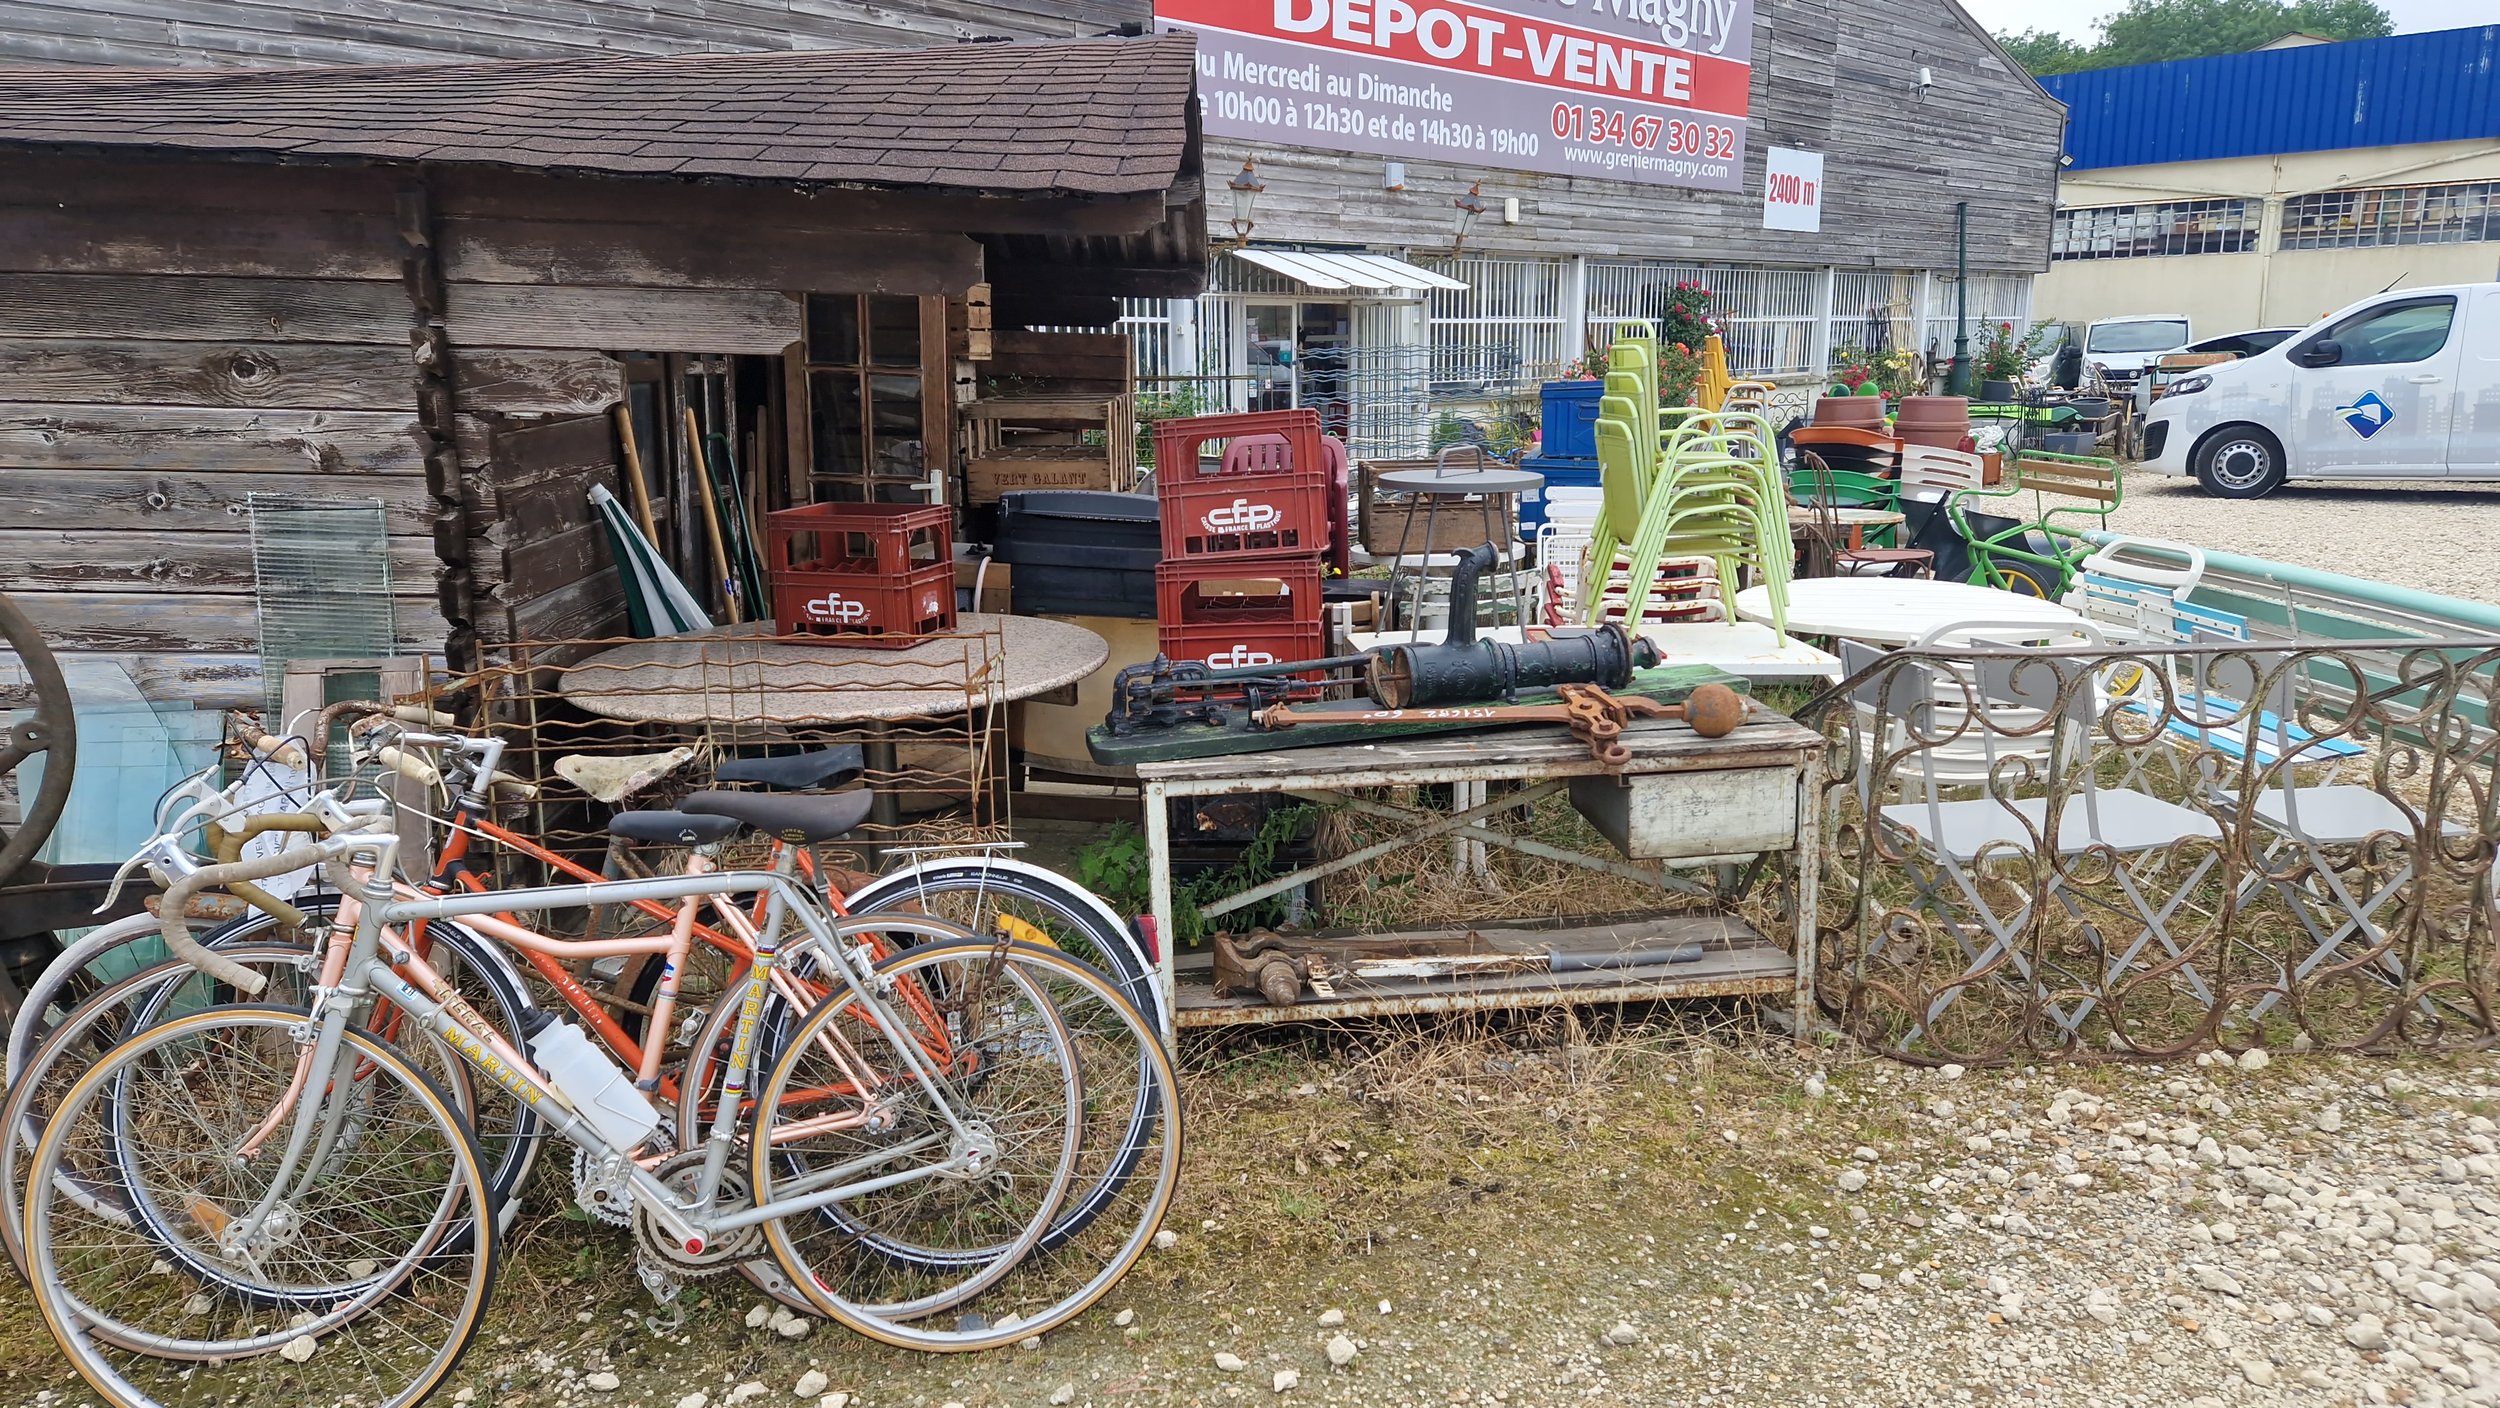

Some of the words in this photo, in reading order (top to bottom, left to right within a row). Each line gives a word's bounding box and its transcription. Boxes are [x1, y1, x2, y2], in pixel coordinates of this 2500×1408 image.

[1593, 0, 1737, 54] agny
[1223, 50, 1320, 93] Mercredi
[1326, 74, 1351, 98] au
[1358, 73, 1453, 112] Dimanche
[1214, 90, 1281, 125] 10h00
[1285, 98, 1298, 127] à
[1303, 102, 1364, 136] 12h30
[1368, 114, 1388, 139] et
[1391, 113, 1416, 142] de
[1420, 118, 1472, 150] 14h30
[1475, 125, 1486, 151] à
[1490, 129, 1539, 157] 19h00
[1551, 101, 1584, 142] 01
[1588, 107, 1626, 147] 34
[1630, 114, 1664, 151] 67
[1667, 119, 1701, 155] 30
[1704, 125, 1736, 161] 32
[1564, 147, 1728, 180] www.greniermagny.com
[1768, 172, 1801, 205] 2400
[992, 473, 1027, 485] VERT
[1032, 472, 1087, 485] GALANT
[1208, 498, 1274, 530] cfp
[807, 592, 865, 624] cfp
[730, 964, 772, 1070] MARTIN
[442, 1026, 544, 1106] MARTIN
